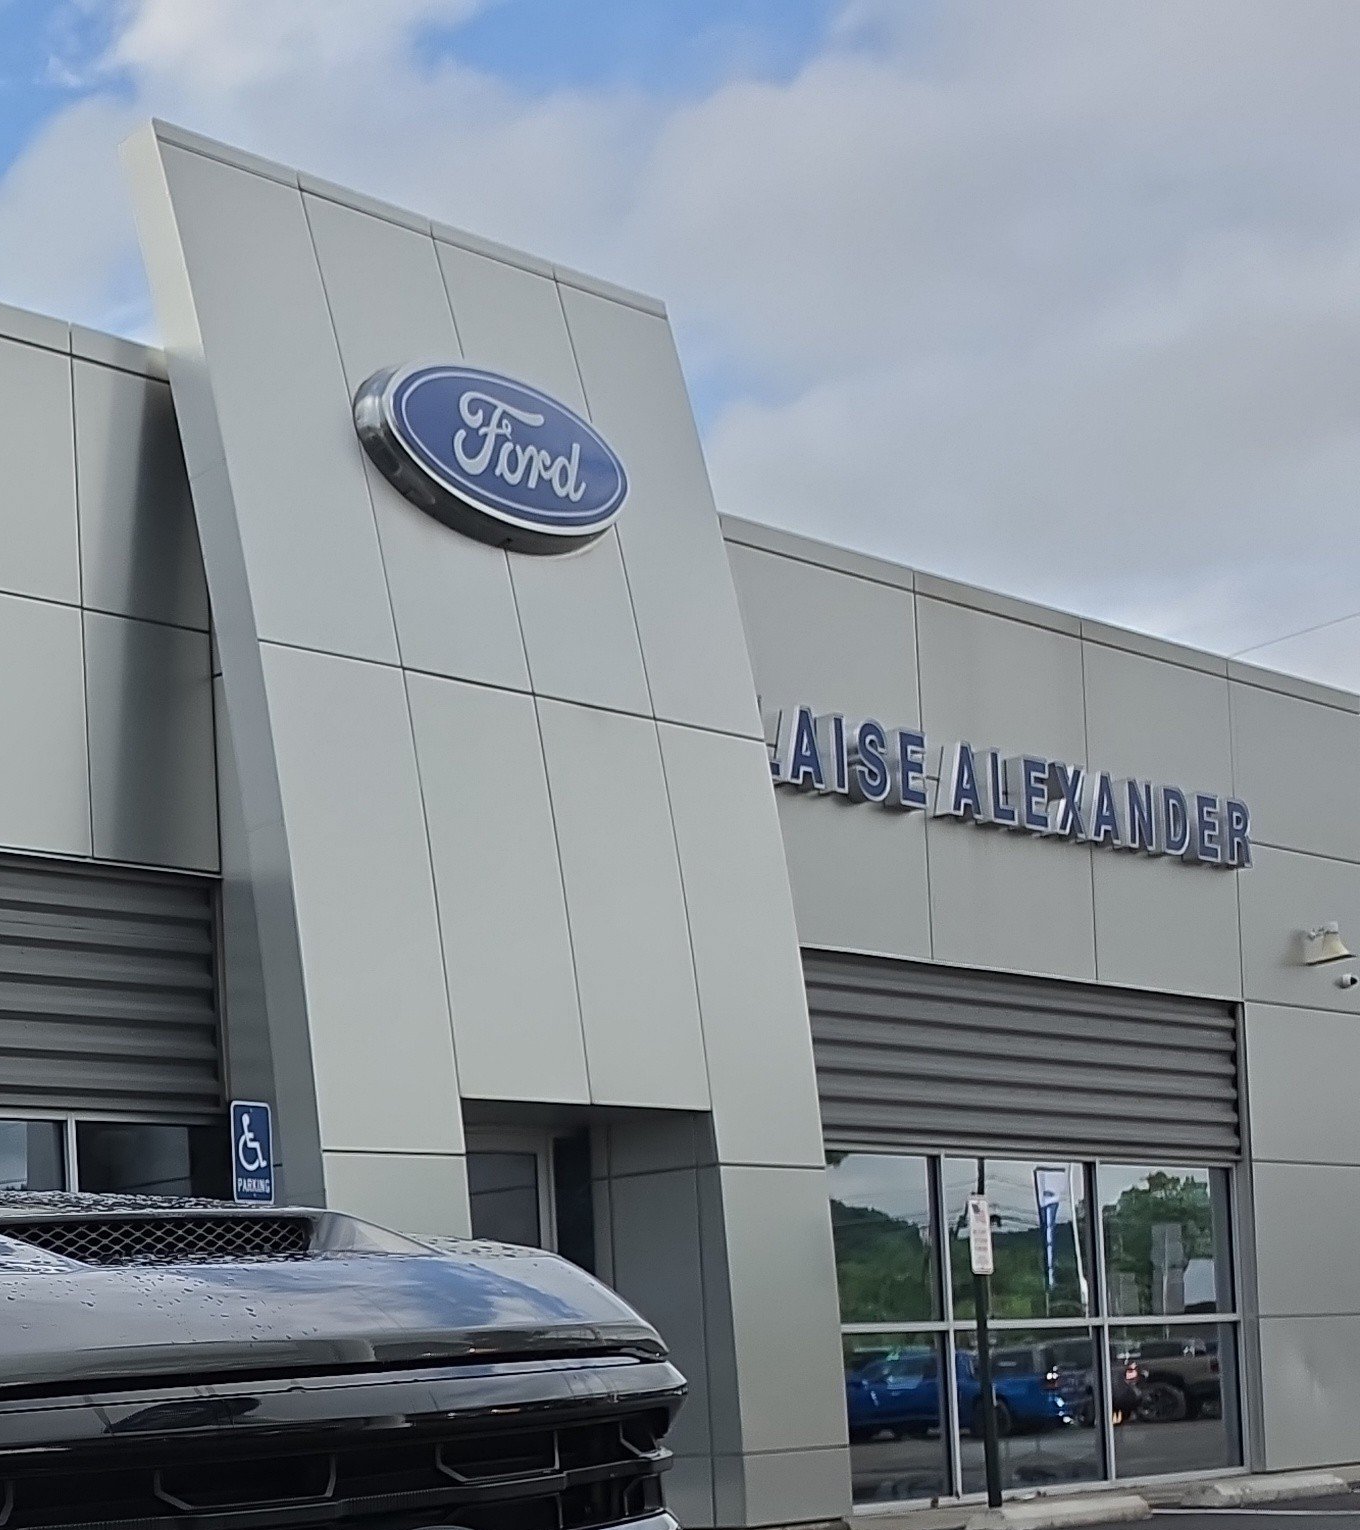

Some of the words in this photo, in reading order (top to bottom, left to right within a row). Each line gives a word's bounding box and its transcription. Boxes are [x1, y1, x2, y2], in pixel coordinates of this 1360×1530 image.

[453, 391, 586, 502] Ford
[770, 705, 927, 810] AISE
[940, 740, 1254, 868] ALEXANDER
[237, 1177, 271, 1194] PARKING
